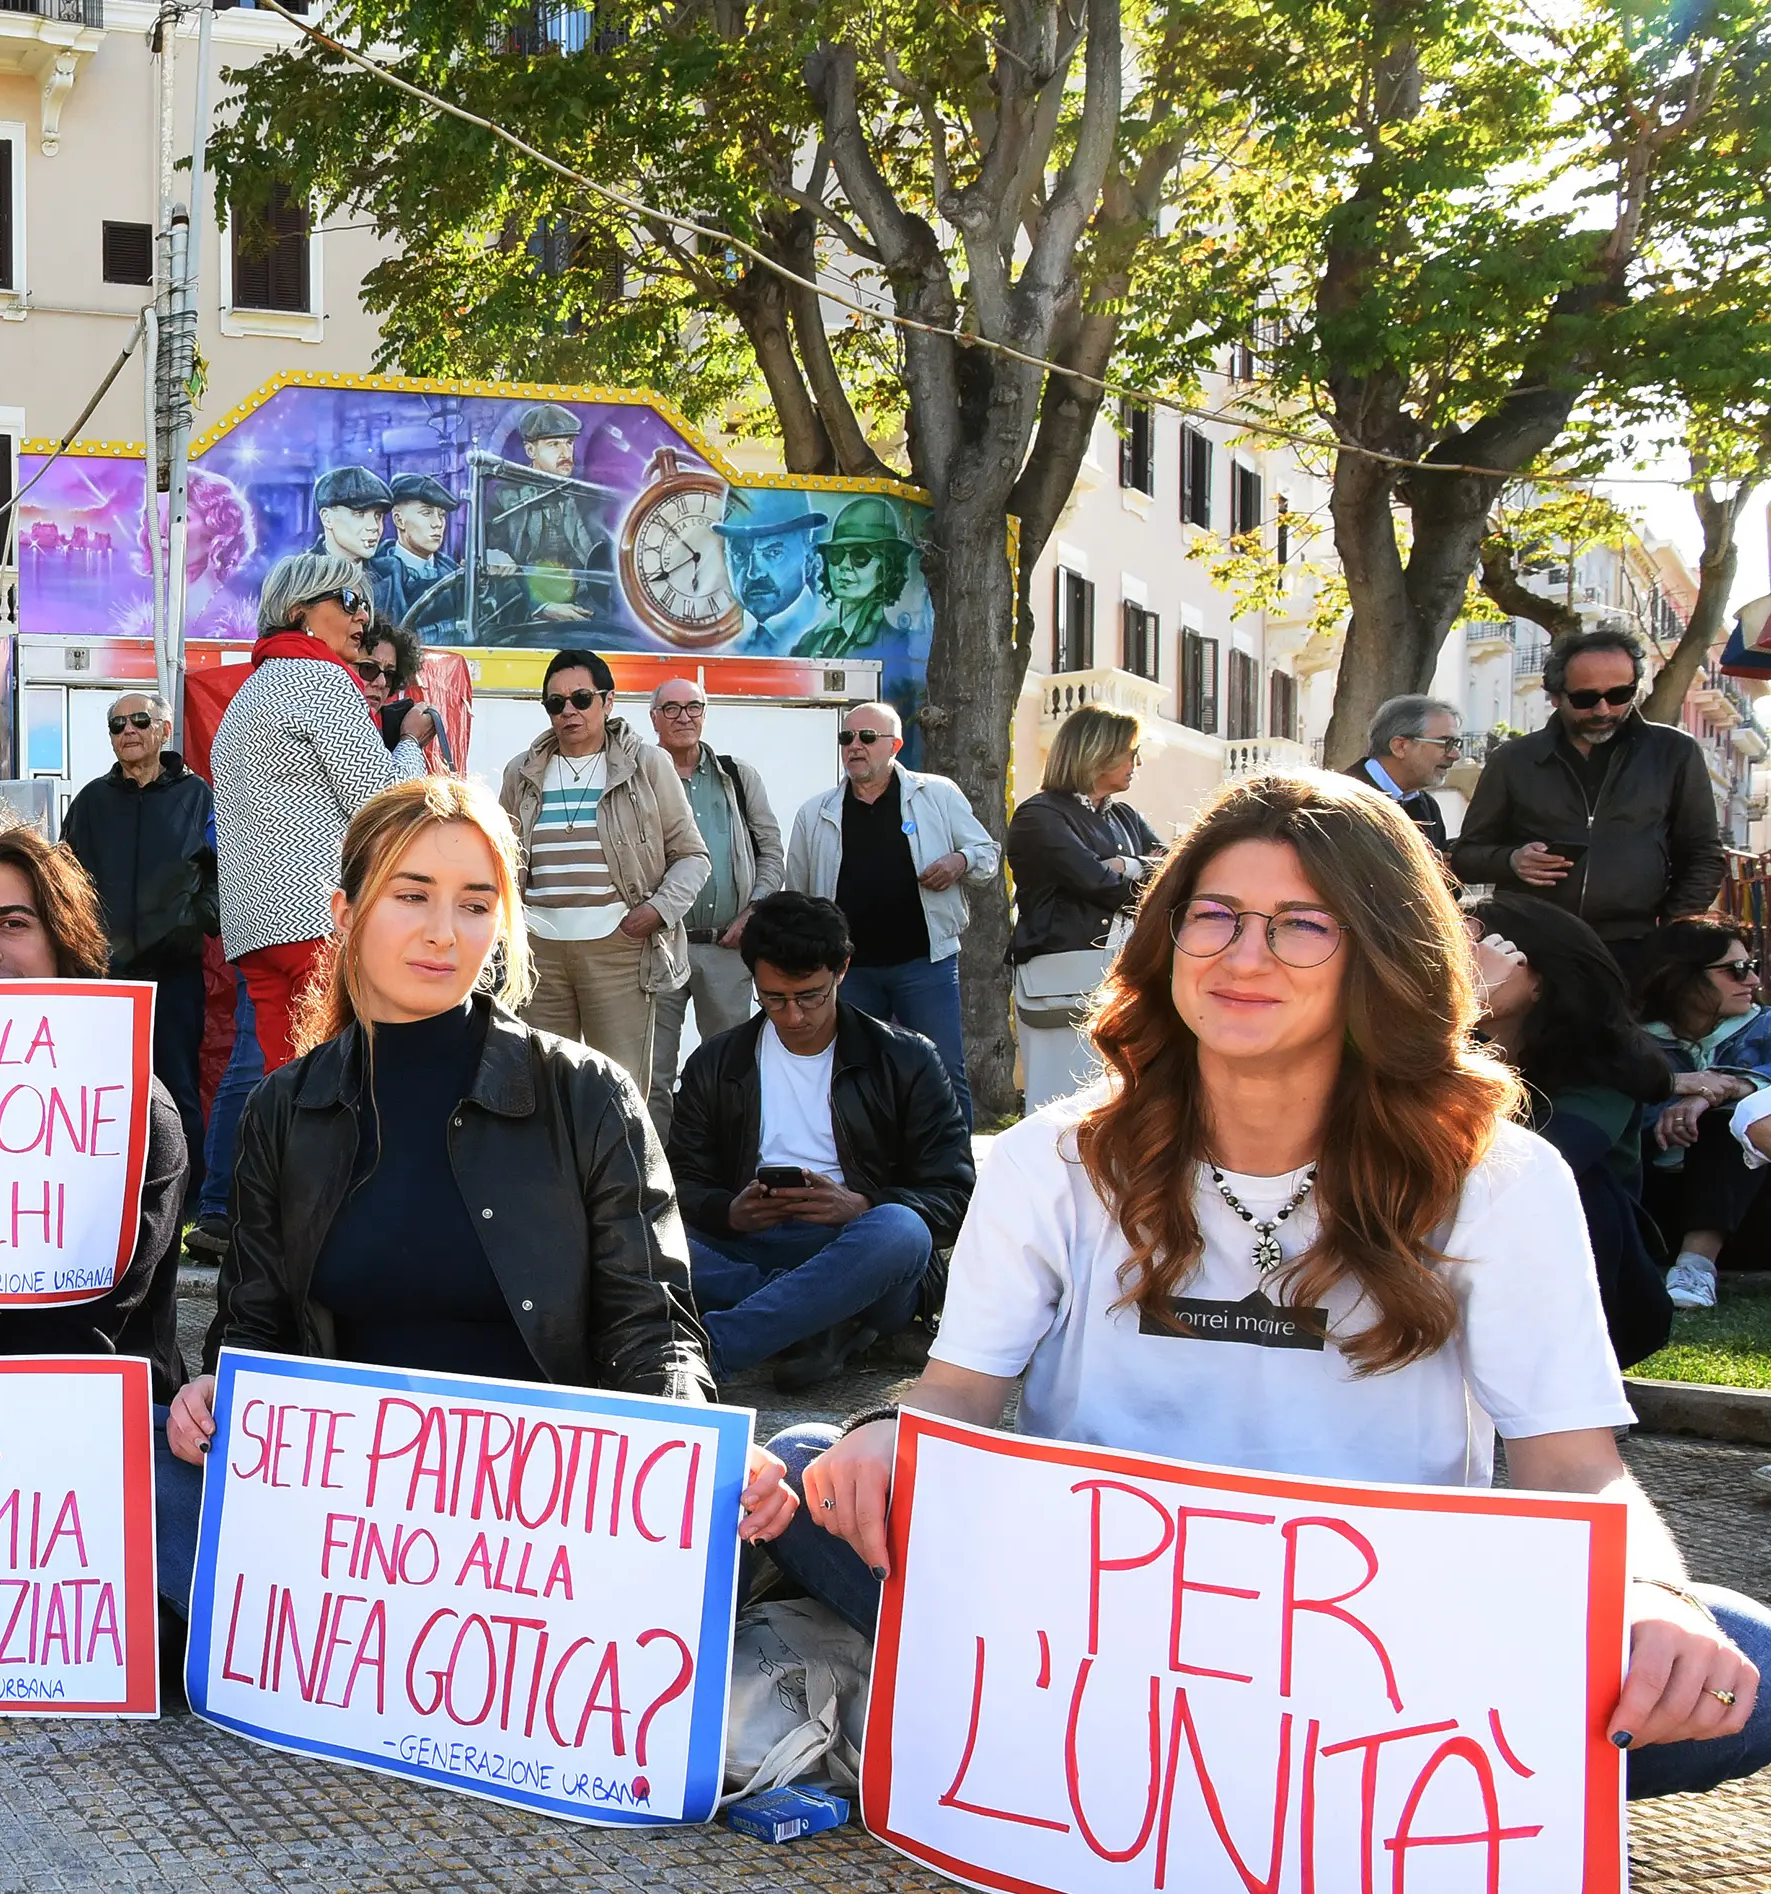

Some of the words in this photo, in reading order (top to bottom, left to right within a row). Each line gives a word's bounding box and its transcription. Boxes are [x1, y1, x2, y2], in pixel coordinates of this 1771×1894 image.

[53, 1267, 114, 1291] URBANA
[231, 1399, 356, 1489] SIETE
[365, 1397, 702, 1550] PATRIOTTICI
[320, 1512, 440, 1586] FINO
[454, 1531, 574, 1601] ALLA
[1070, 1479, 1404, 1714] PER
[221, 1573, 386, 1715] LINEA
[405, 1607, 694, 1798] GOTICA?
[561, 1772, 652, 1809] URBANA
